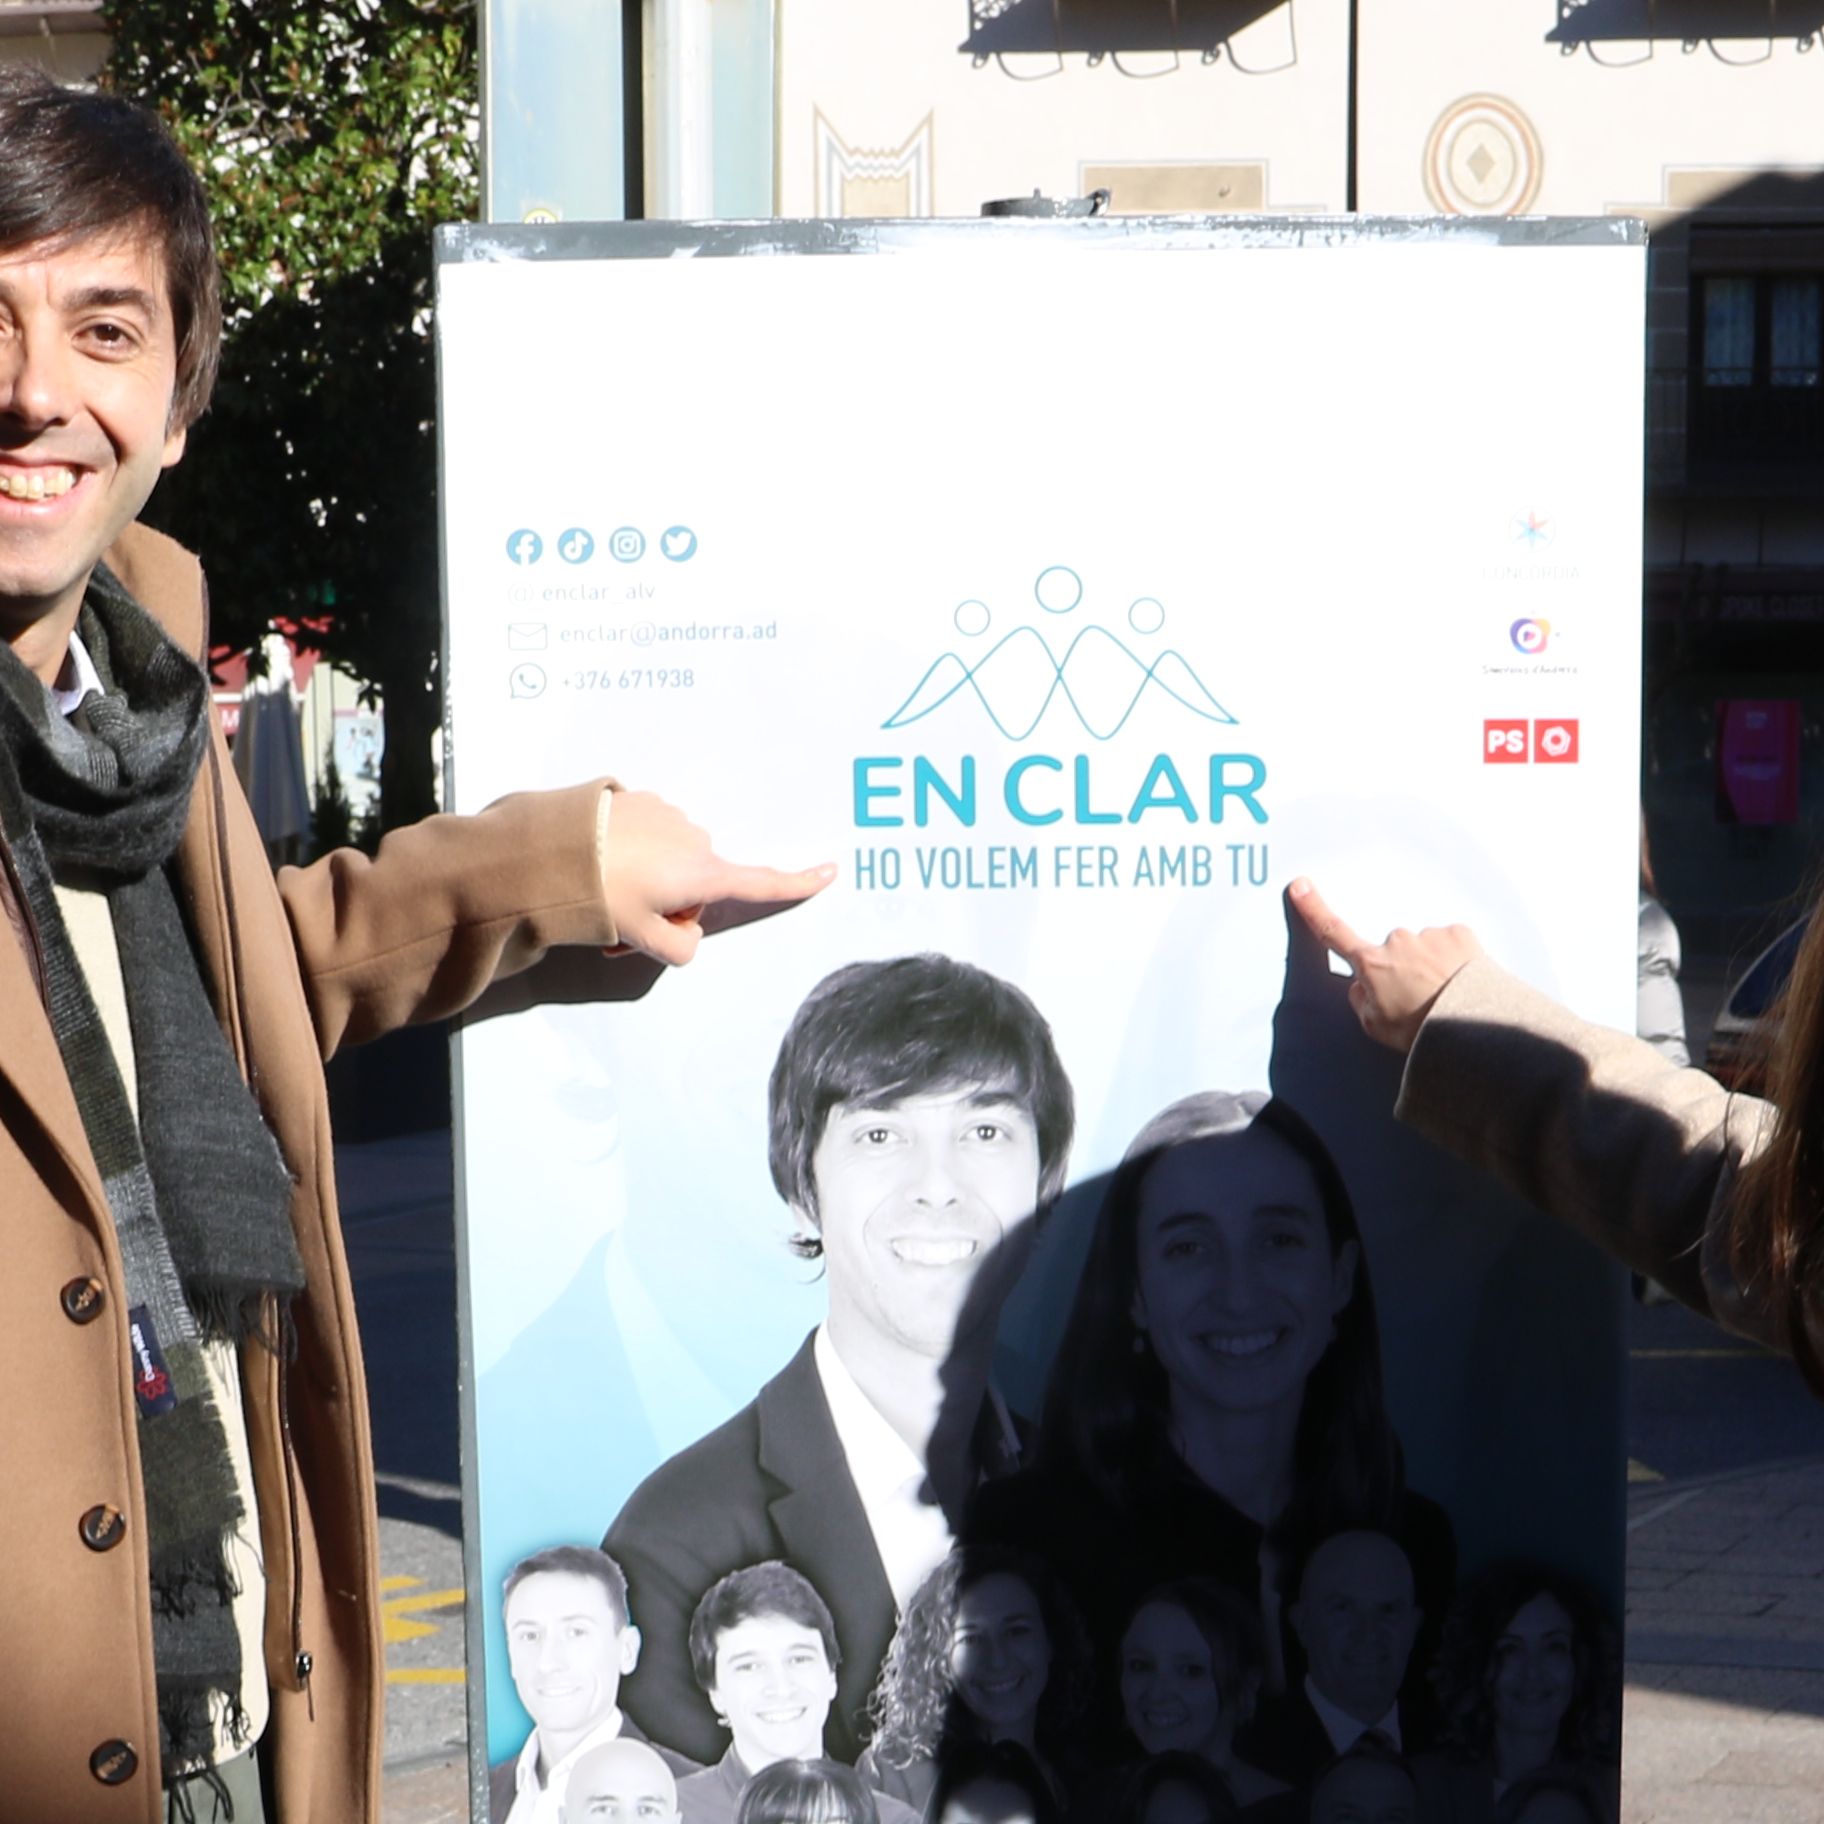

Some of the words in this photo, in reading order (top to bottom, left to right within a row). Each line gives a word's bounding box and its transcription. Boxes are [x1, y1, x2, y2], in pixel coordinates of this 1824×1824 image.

[560, 621, 778, 647] enclar@andorra.ad
[563, 671, 611, 690] +376
[618, 669, 695, 689] 671938
[1487, 729, 1524, 754] PS
[852, 755, 976, 828] EN
[1003, 752, 1270, 827] CLAR
[854, 847, 902, 890] HO
[915, 845, 1039, 889] VOLEM
[1054, 845, 1120, 888] FER
[1132, 845, 1213, 888] AMB
[1225, 844, 1269, 887] TU
